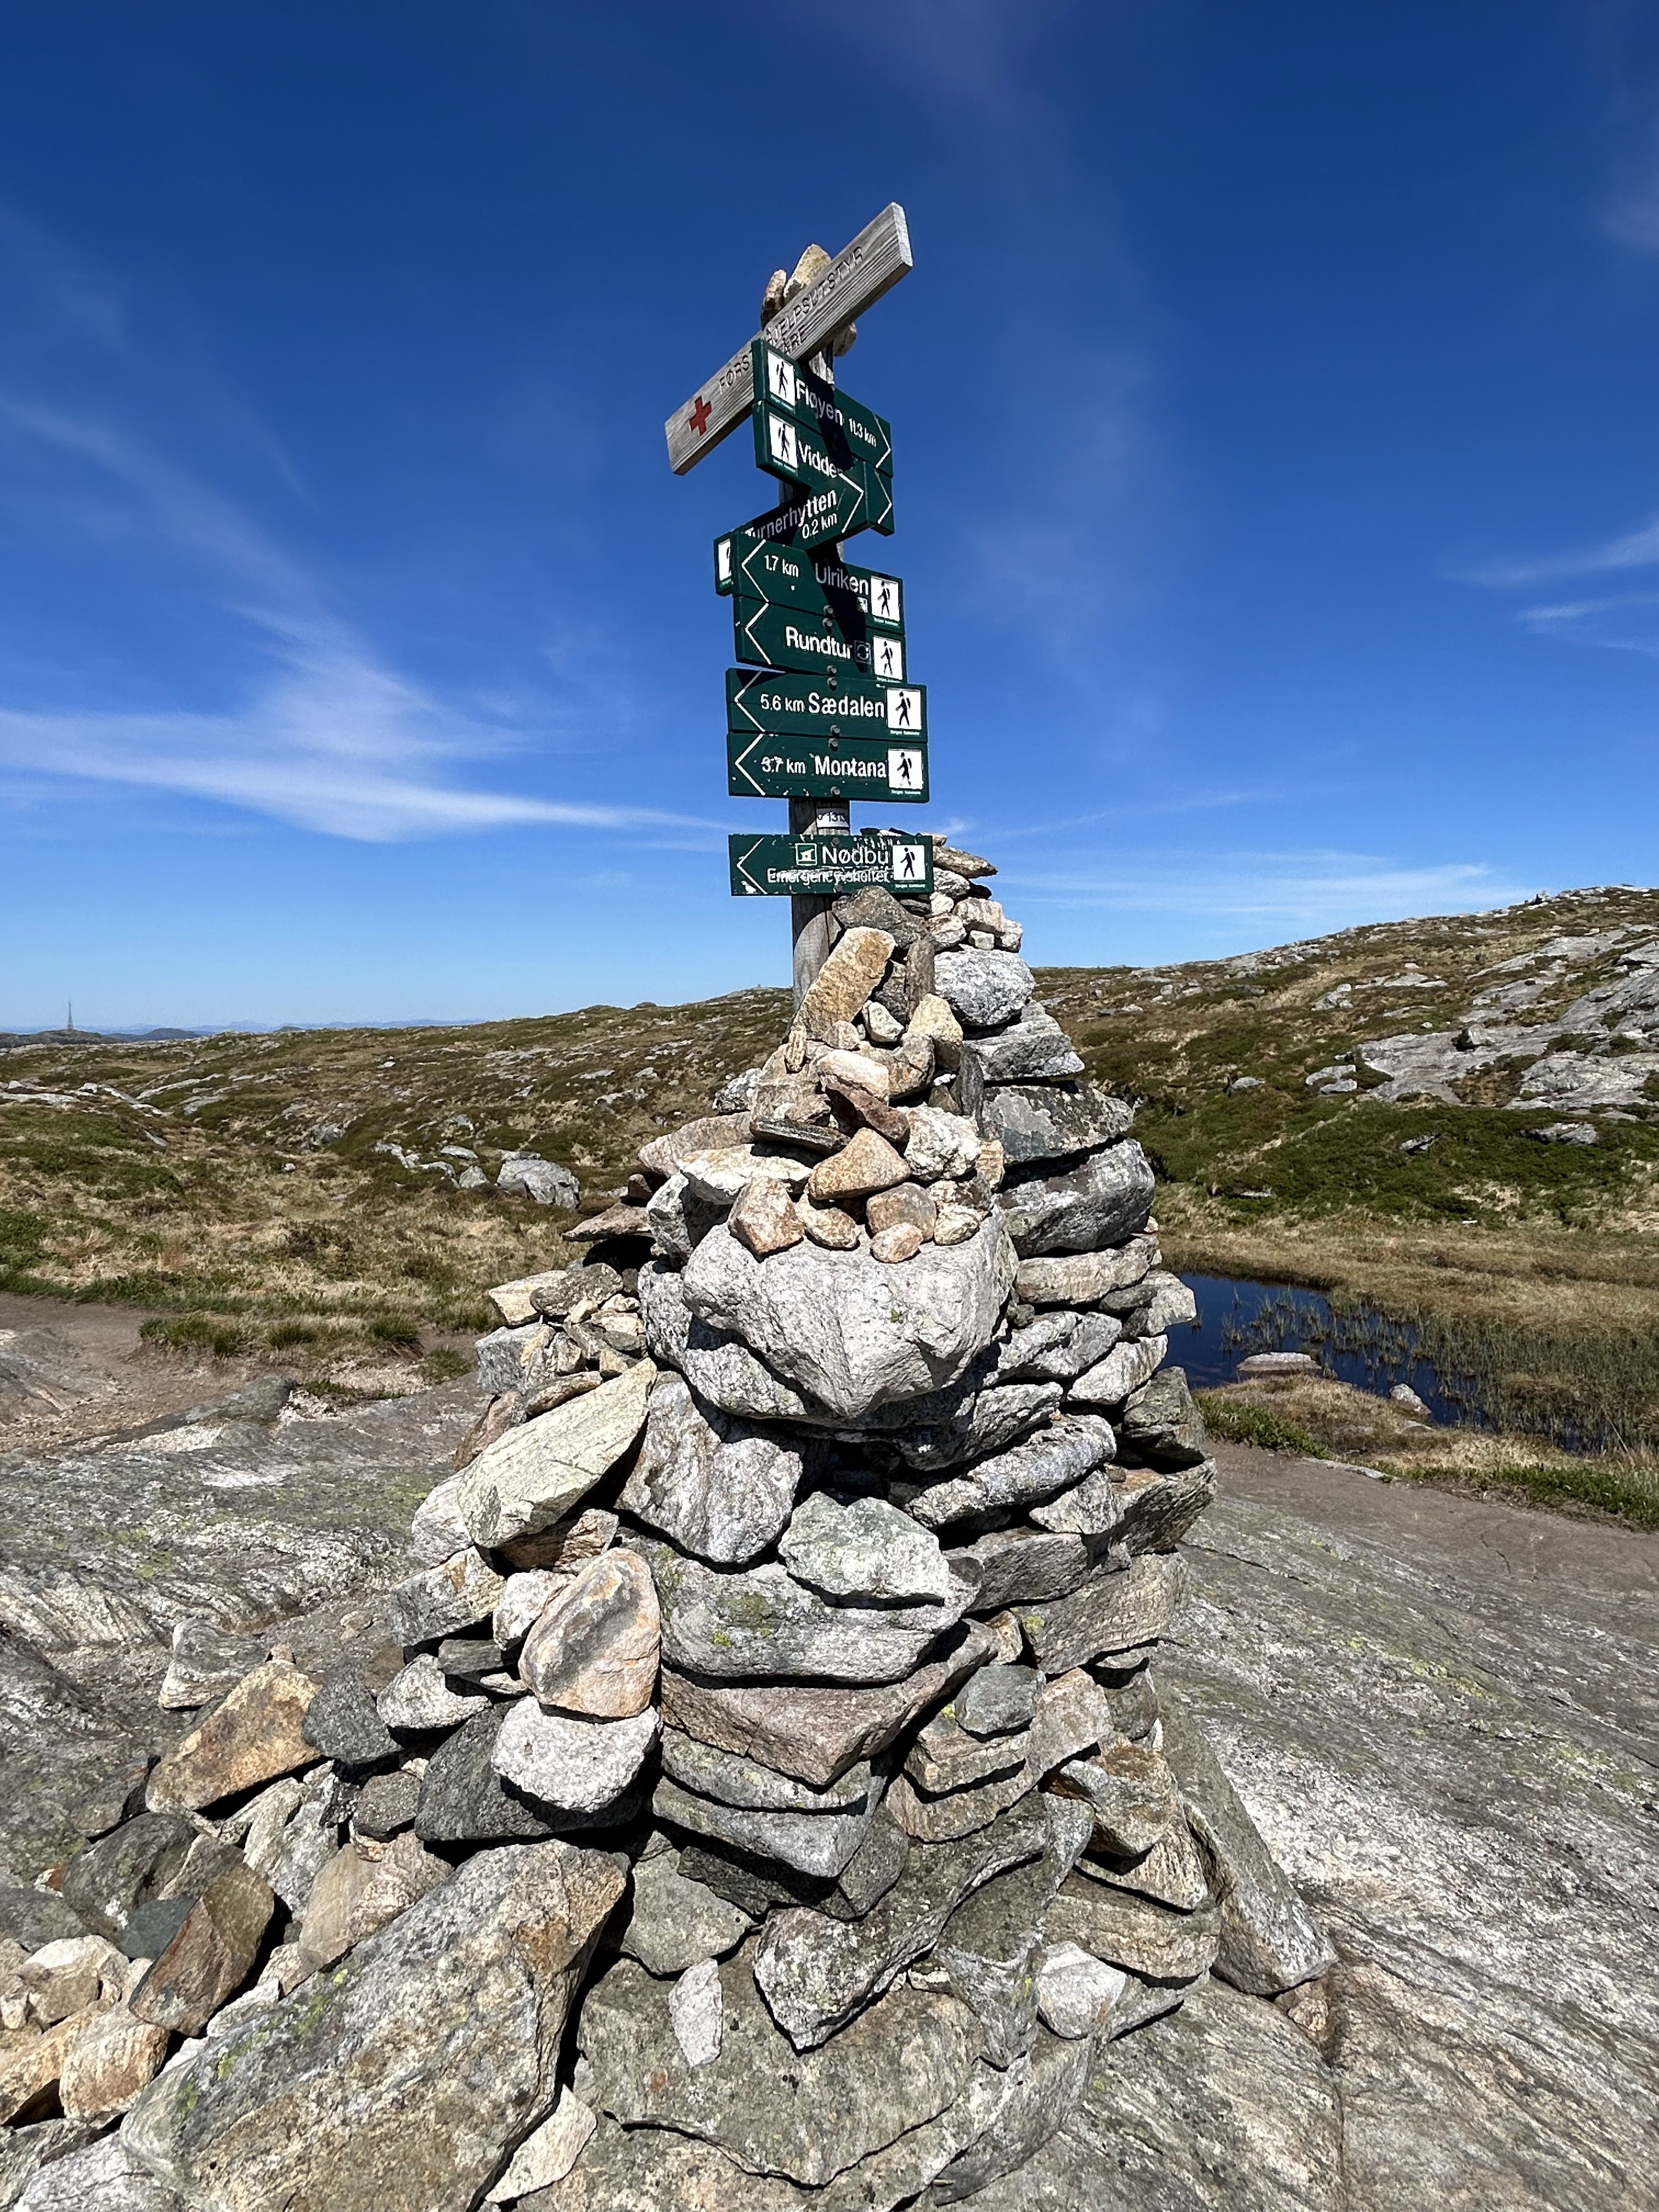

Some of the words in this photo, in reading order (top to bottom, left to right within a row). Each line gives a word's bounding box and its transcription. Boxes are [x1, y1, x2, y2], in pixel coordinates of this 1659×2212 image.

[796, 378, 844, 426] Fløyen
[865, 427, 877, 447] km
[802, 519, 819, 539] 0.2
[821, 512, 837, 531] km
[764, 554, 778, 571] 1.7
[782, 558, 799, 577] km
[815, 563, 869, 595] Ulriken
[786, 626, 852, 659] Rundtur
[760, 693, 781, 711] 5.6
[785, 697, 805, 712] km
[808, 692, 884, 718] Sædalen
[761, 756, 784, 772] 3.7
[786, 758, 806, 774] km
[814, 754, 887, 778] Montana
[822, 846, 889, 865] Nødbu
[768, 868, 843, 885] Emergency
